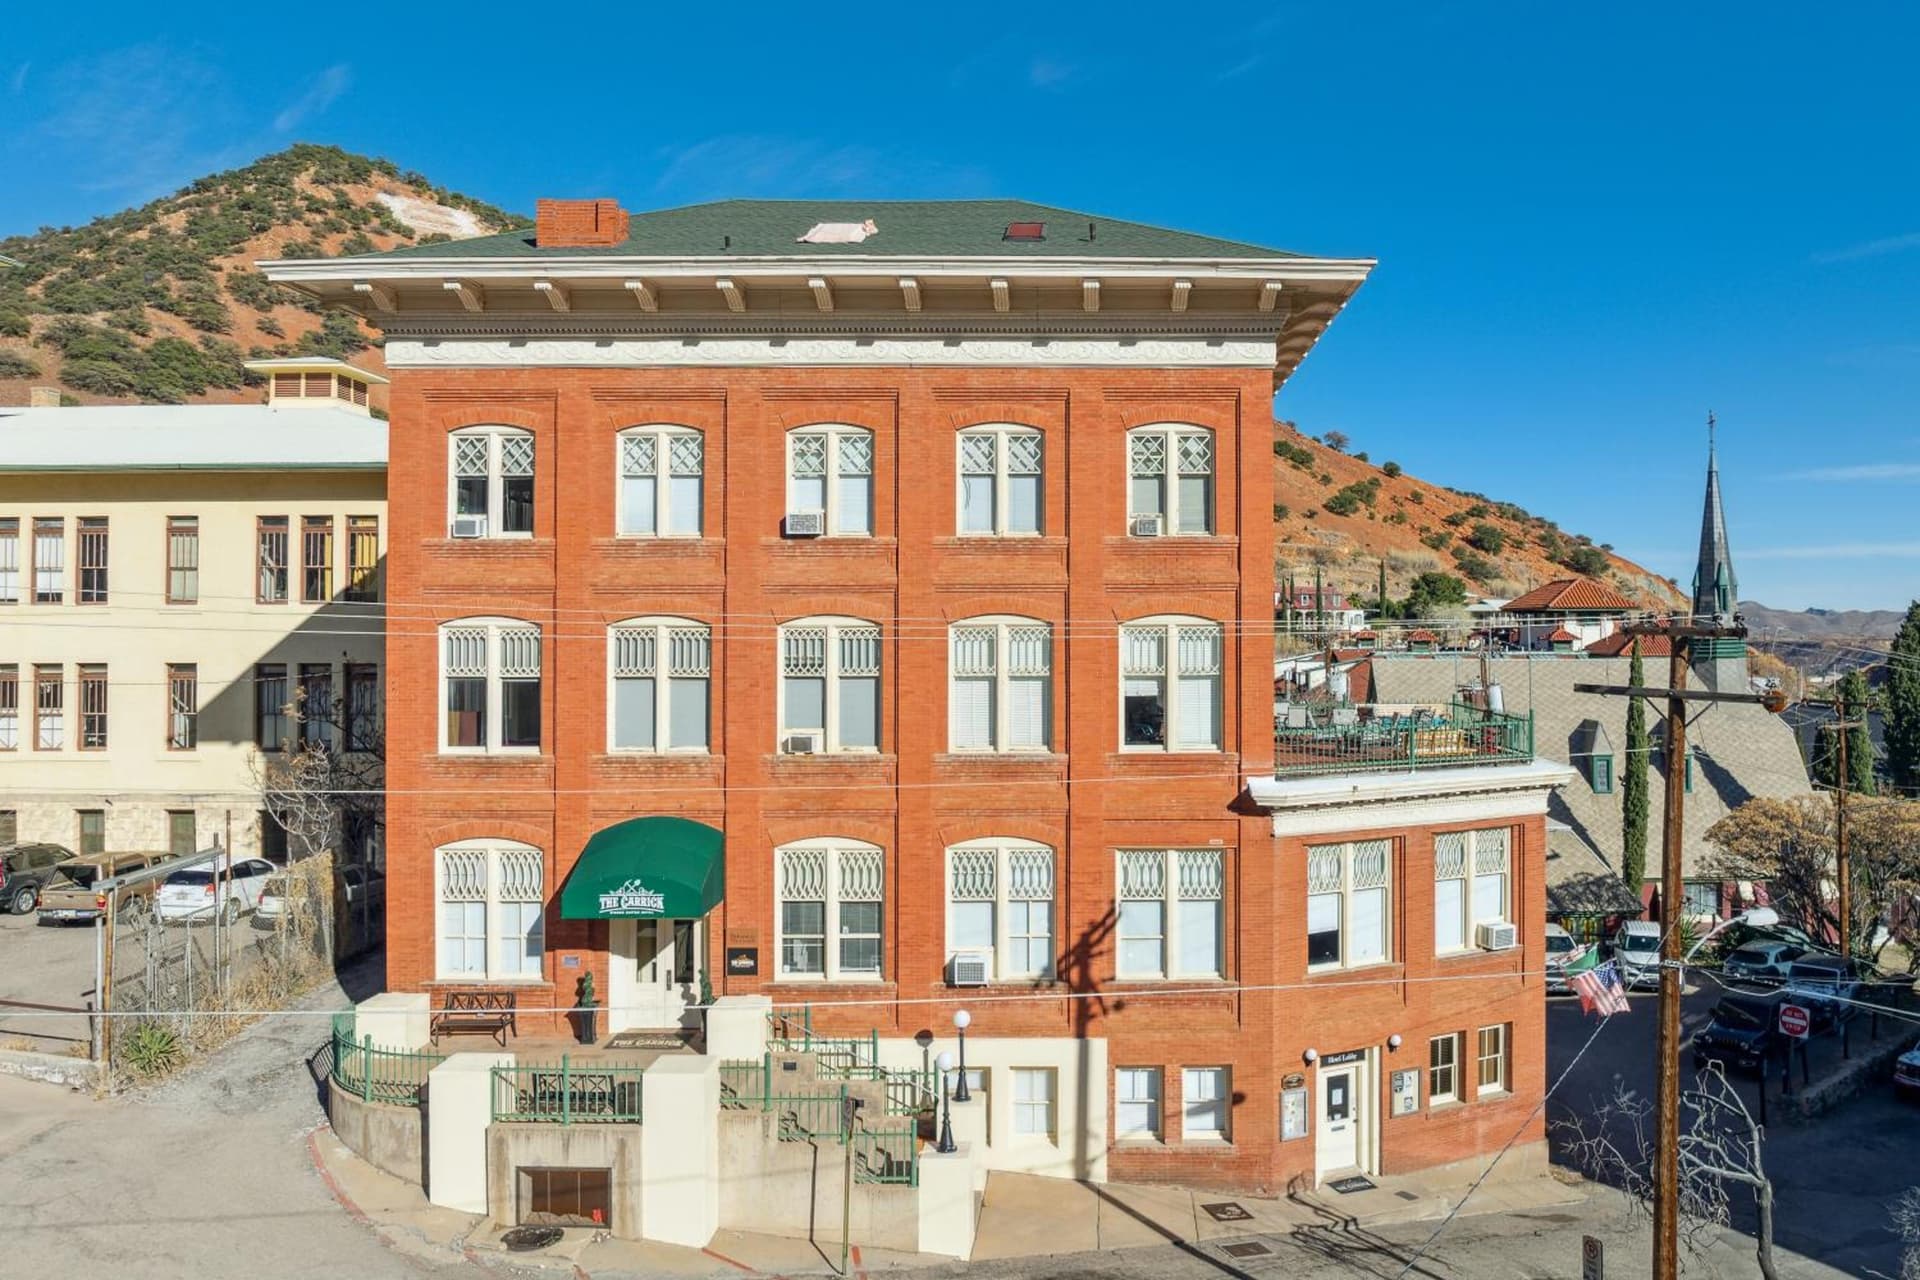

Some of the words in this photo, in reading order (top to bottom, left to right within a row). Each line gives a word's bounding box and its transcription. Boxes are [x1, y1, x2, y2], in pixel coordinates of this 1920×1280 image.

[600, 896, 619, 909] THE
[621, 895, 664, 909] CARRICK
[612, 1039, 634, 1047] THE
[635, 1039, 684, 1047] CARRICK
